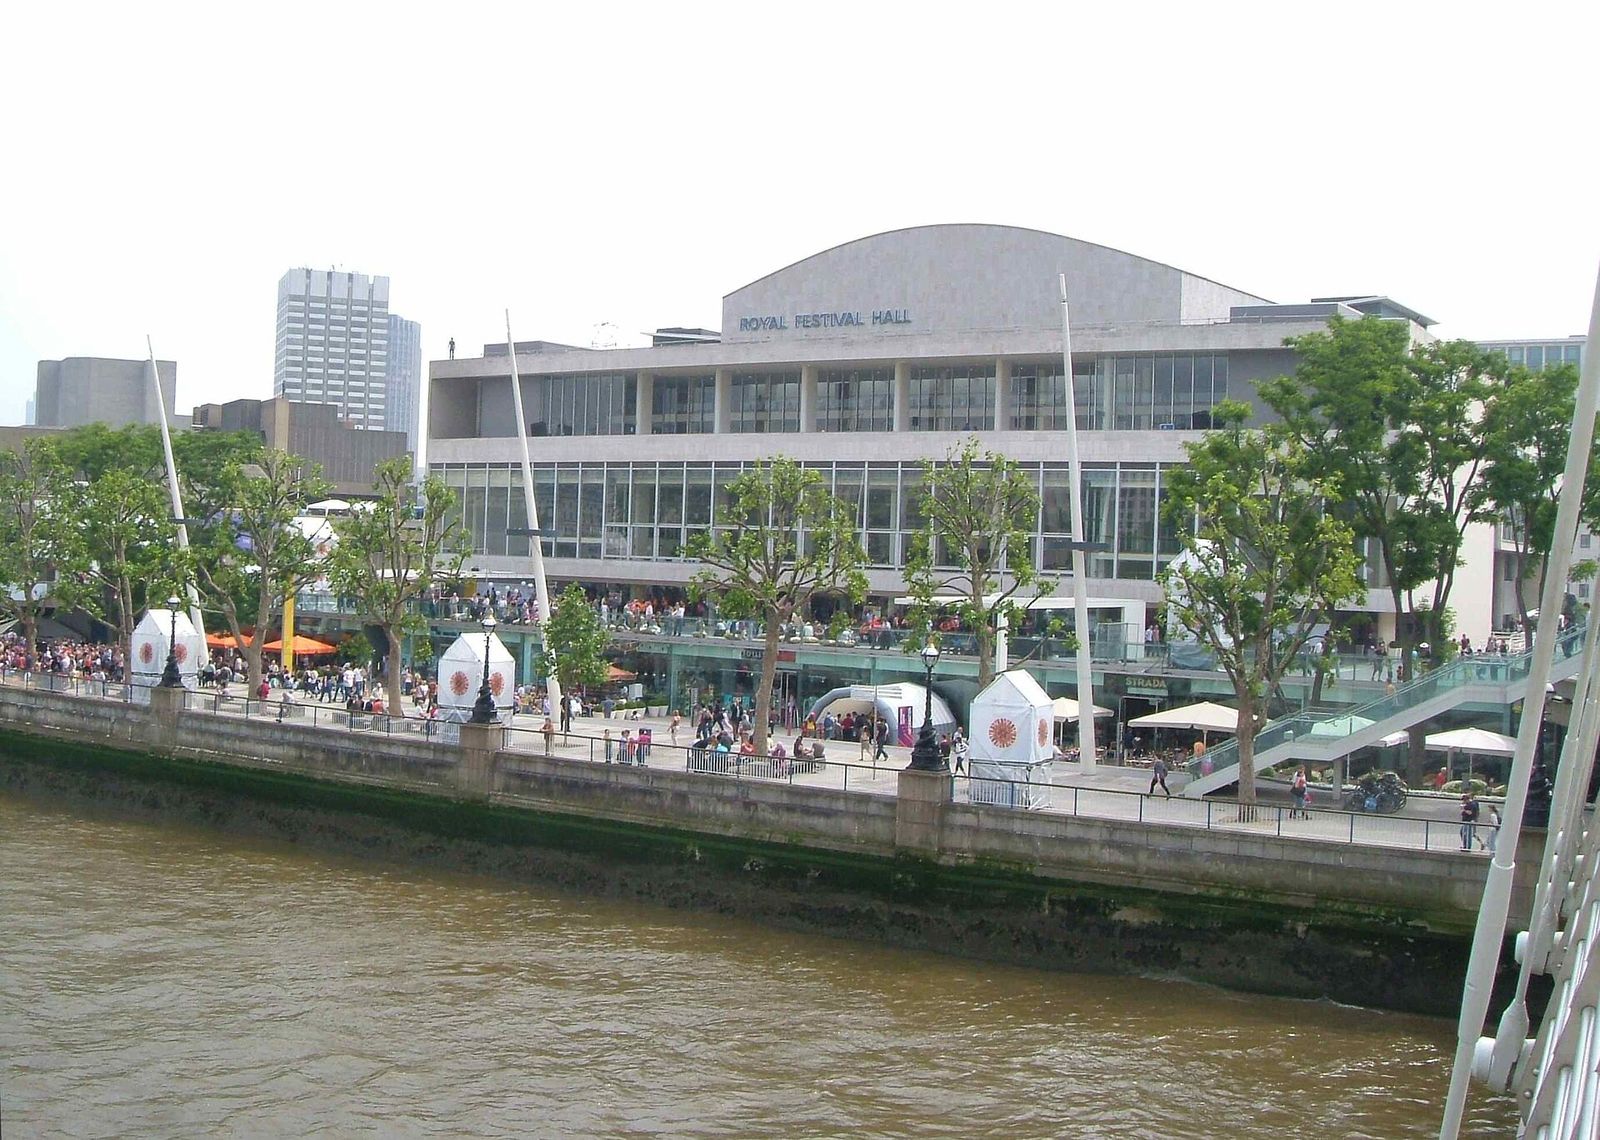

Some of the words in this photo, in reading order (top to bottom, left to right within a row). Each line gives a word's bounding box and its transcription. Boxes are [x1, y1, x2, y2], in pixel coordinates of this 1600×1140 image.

[740, 316, 787, 331] ROYAL
[795, 312, 864, 328] FESTIVAL
[872, 309, 912, 325] HALL
[1125, 676, 1167, 688] STRADA
